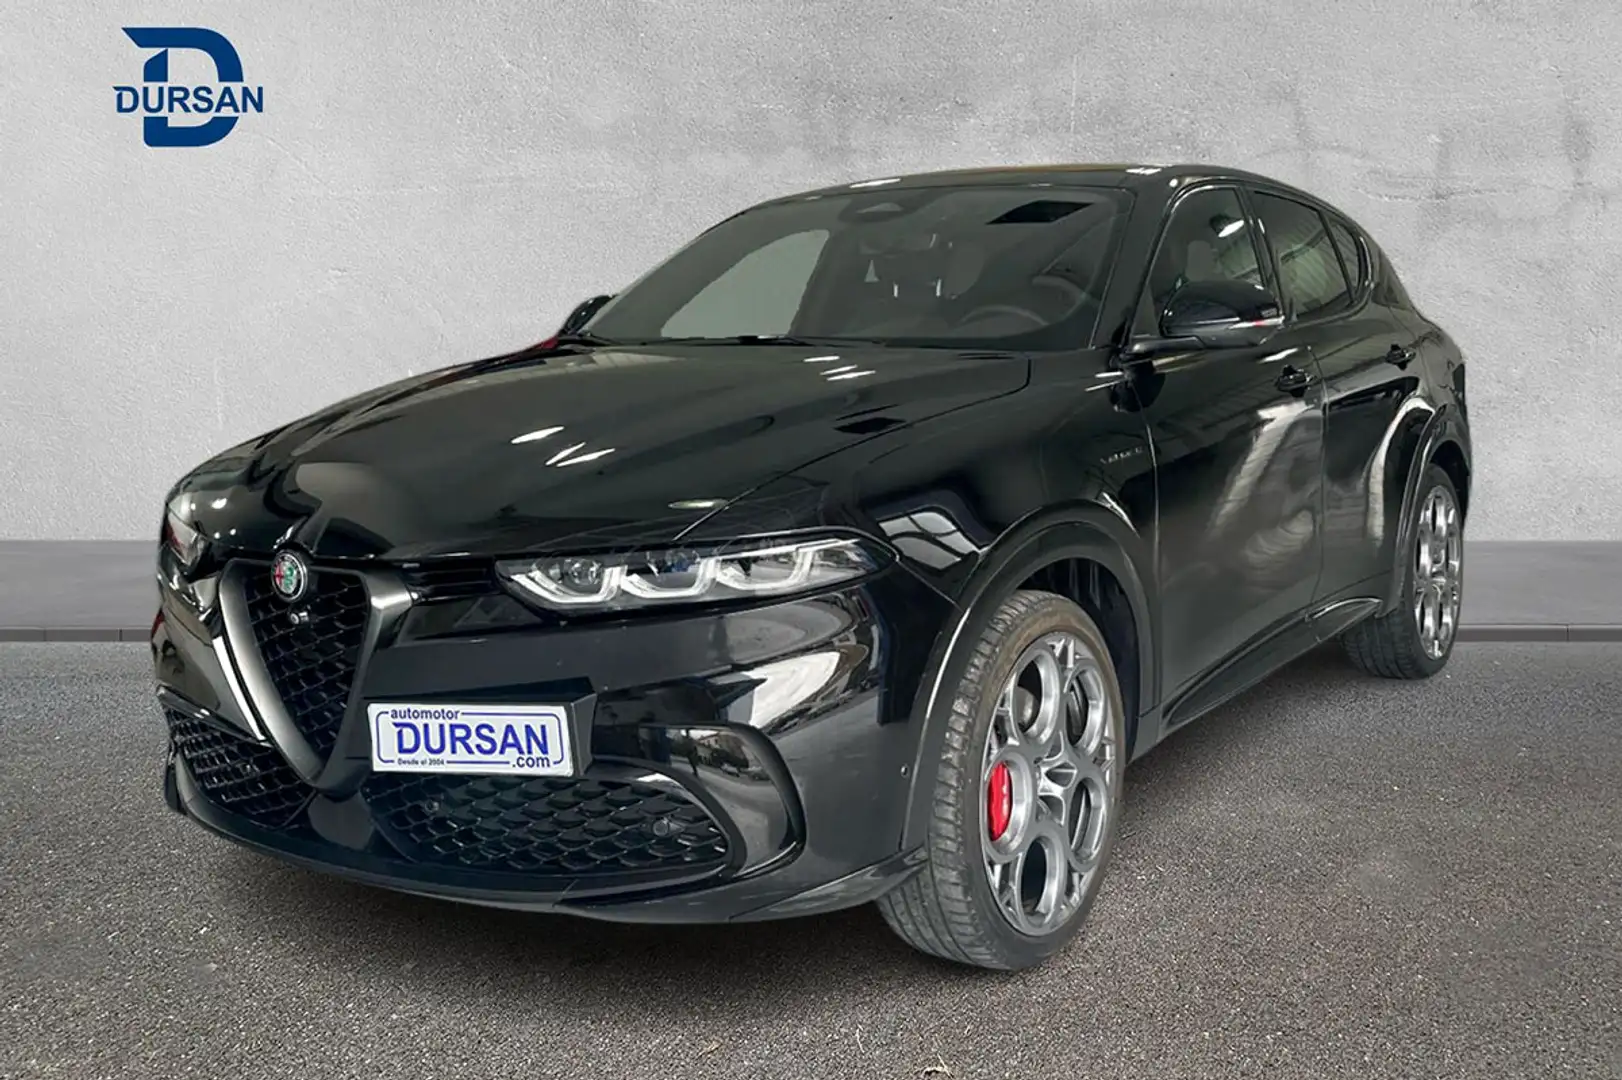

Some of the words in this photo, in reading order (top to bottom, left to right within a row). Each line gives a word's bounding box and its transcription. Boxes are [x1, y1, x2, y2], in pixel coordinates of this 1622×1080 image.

[390, 707, 460, 720] automotor
[392, 721, 549, 756] DURSAN
[397, 757, 419, 766] Desde
[512, 755, 551, 769] .com
